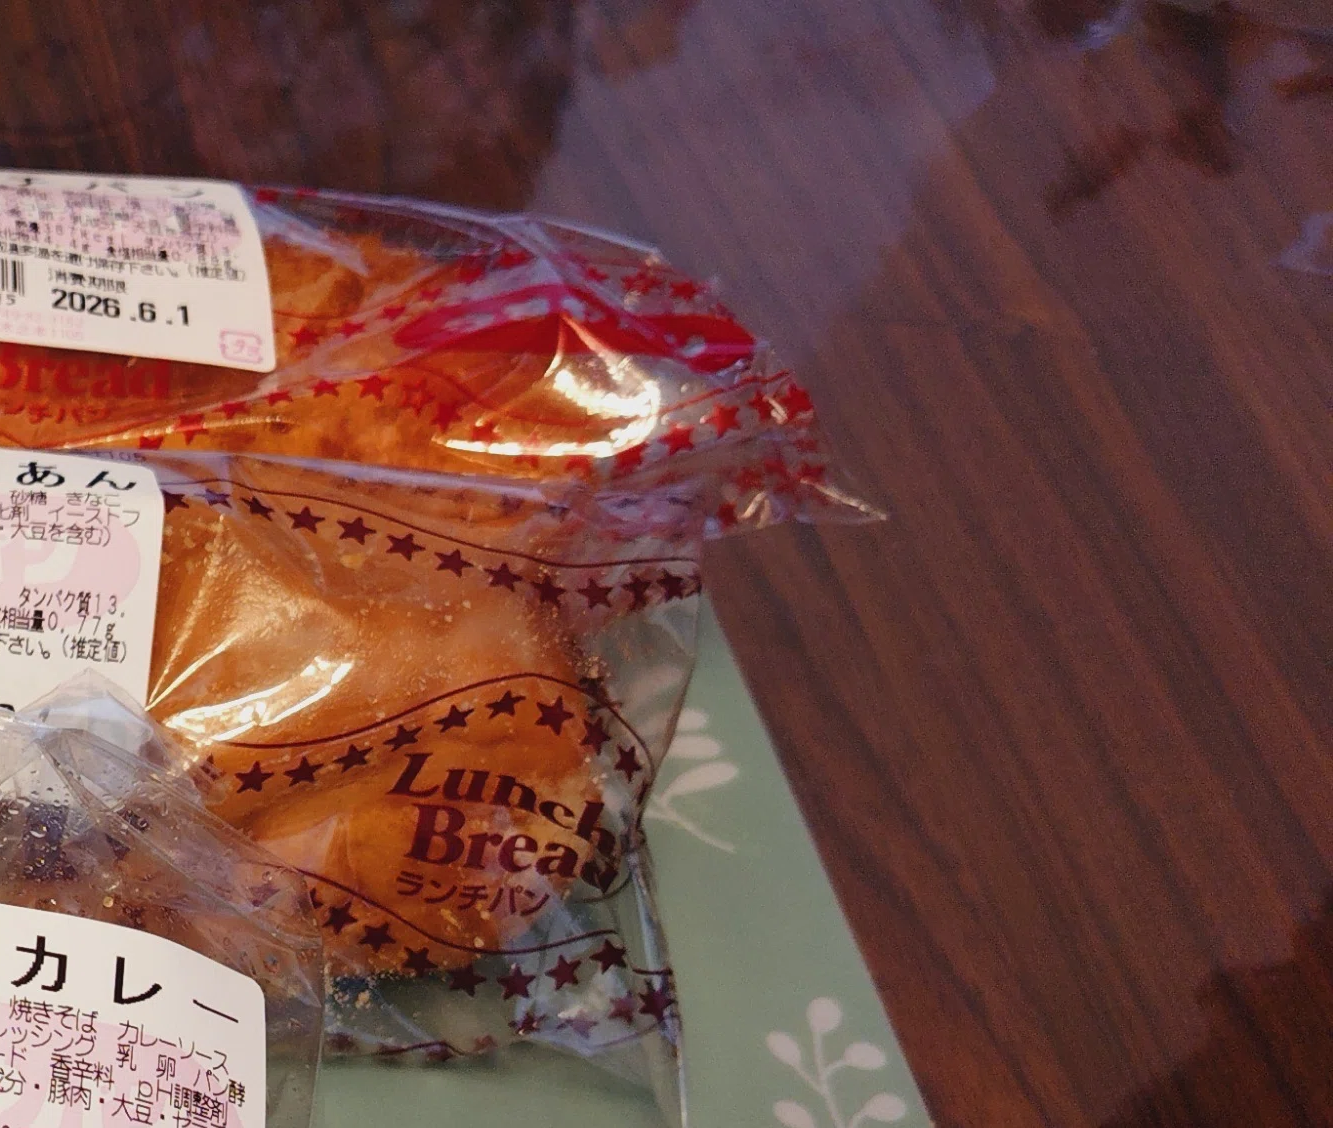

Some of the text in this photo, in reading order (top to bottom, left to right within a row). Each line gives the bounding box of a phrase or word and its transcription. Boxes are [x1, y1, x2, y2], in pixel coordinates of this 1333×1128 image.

[52, 289, 190, 327] 2026.6.1
[10, 490, 47, 505] 砂糖
[66, 492, 121, 507] きなこ
[48, 508, 141, 527] イーストフ
[387, 752, 617, 858] Lunch
[396, 871, 550, 916] ランチパン
[118, 1020, 229, 1075] カレーソース
[50, 1053, 115, 1090] 香辛料
[116, 1043, 137, 1071] 乳
[155, 1054, 176, 1080] 卵
[193, 1069, 246, 1107] パン酵
